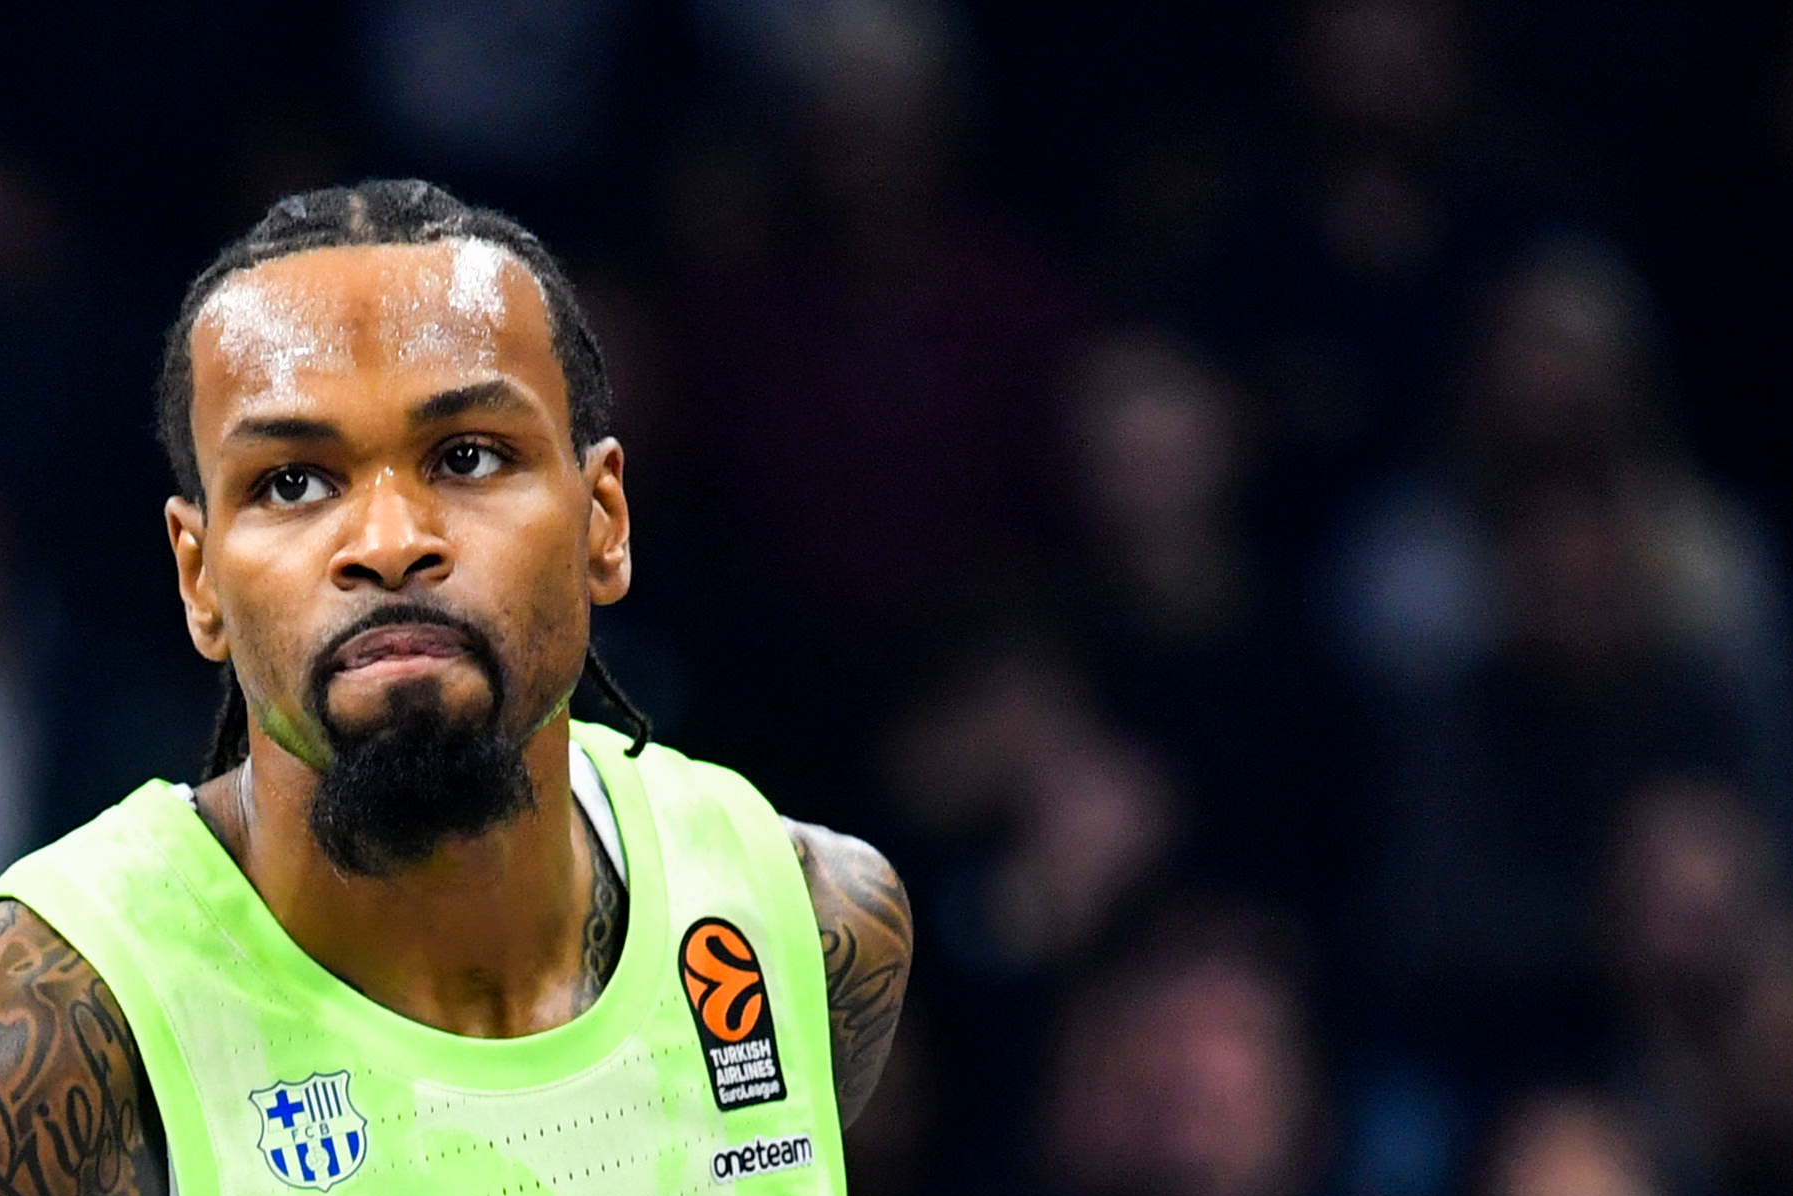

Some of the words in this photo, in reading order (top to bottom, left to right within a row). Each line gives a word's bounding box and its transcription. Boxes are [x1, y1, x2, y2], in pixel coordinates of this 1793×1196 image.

[709, 1038, 772, 1068] TURKISH
[716, 1058, 776, 1087] AIRLINES
[714, 1137, 813, 1178] oneteam
